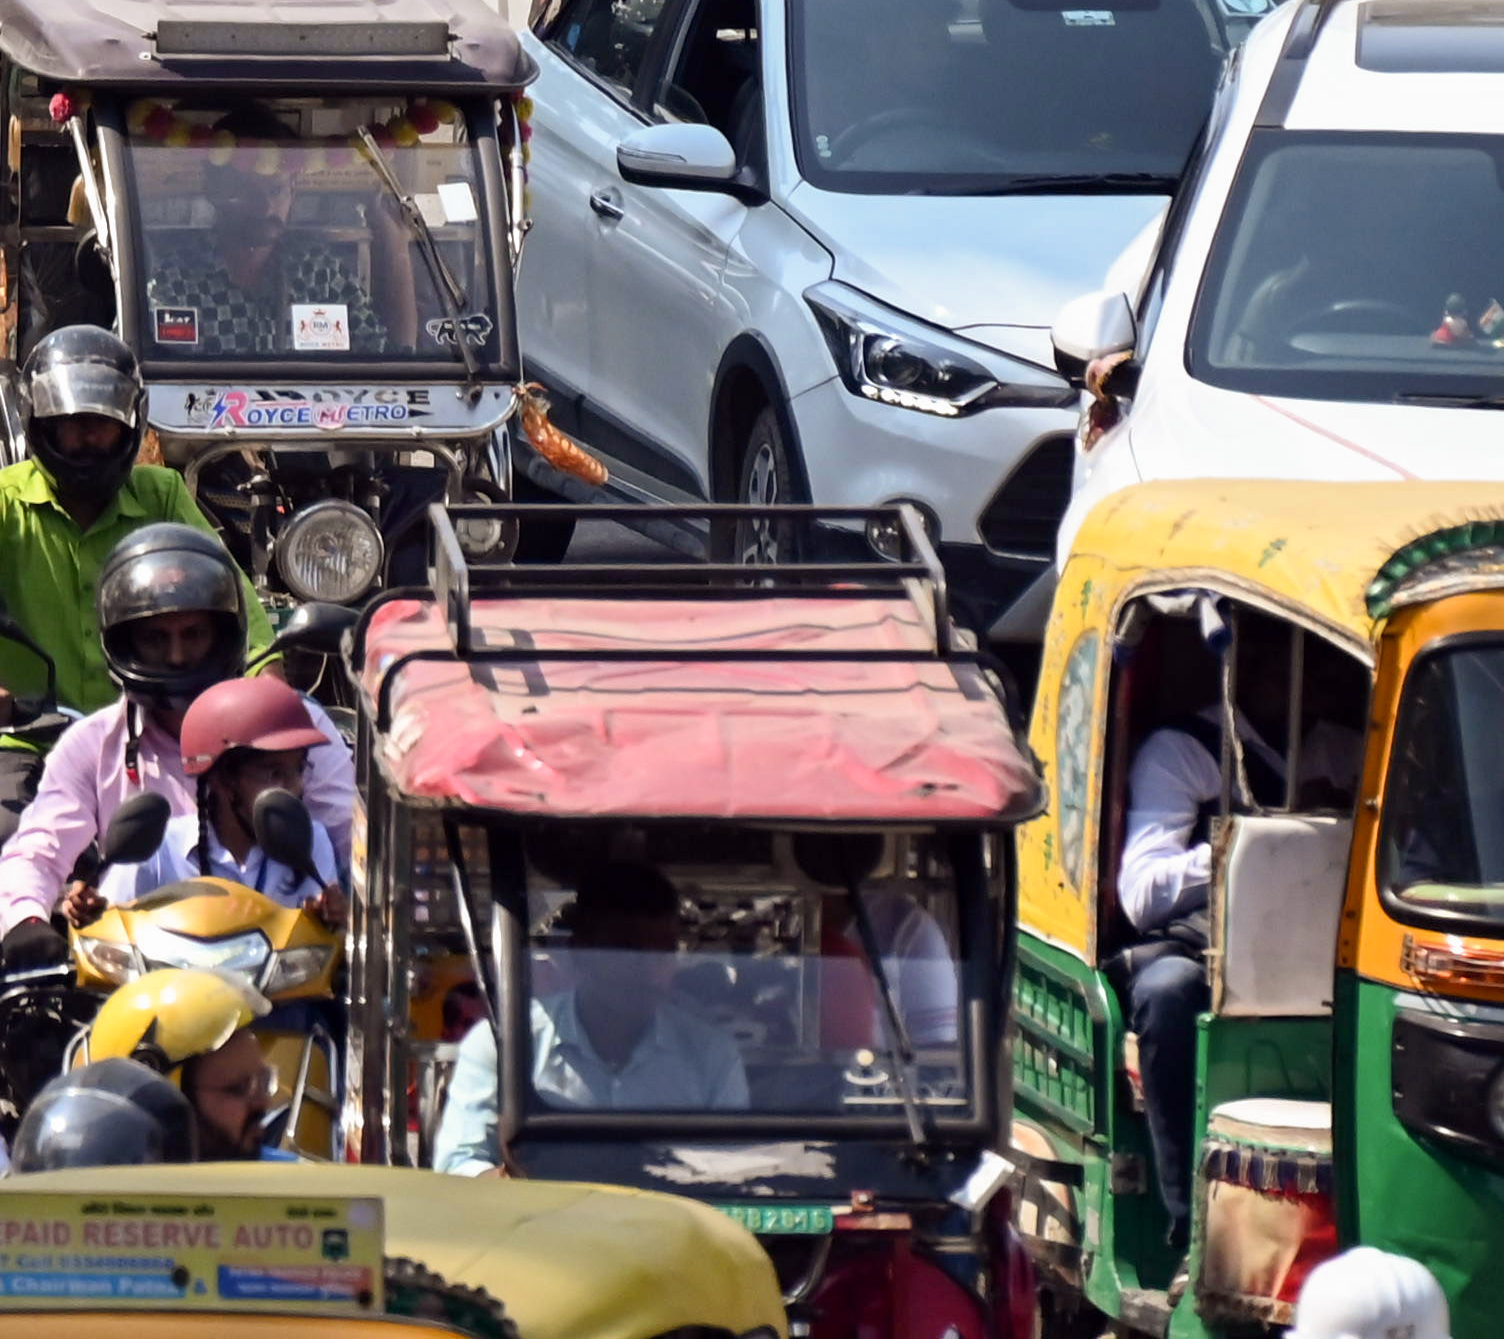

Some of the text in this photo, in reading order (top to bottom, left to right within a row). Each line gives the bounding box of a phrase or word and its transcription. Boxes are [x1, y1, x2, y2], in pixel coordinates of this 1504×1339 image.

[216, 391, 312, 428] ROYCE
[82, 1220, 223, 1250] RESERVE
[233, 1223, 315, 1252] AUTO
[9, 1274, 112, 1295] Chairman
